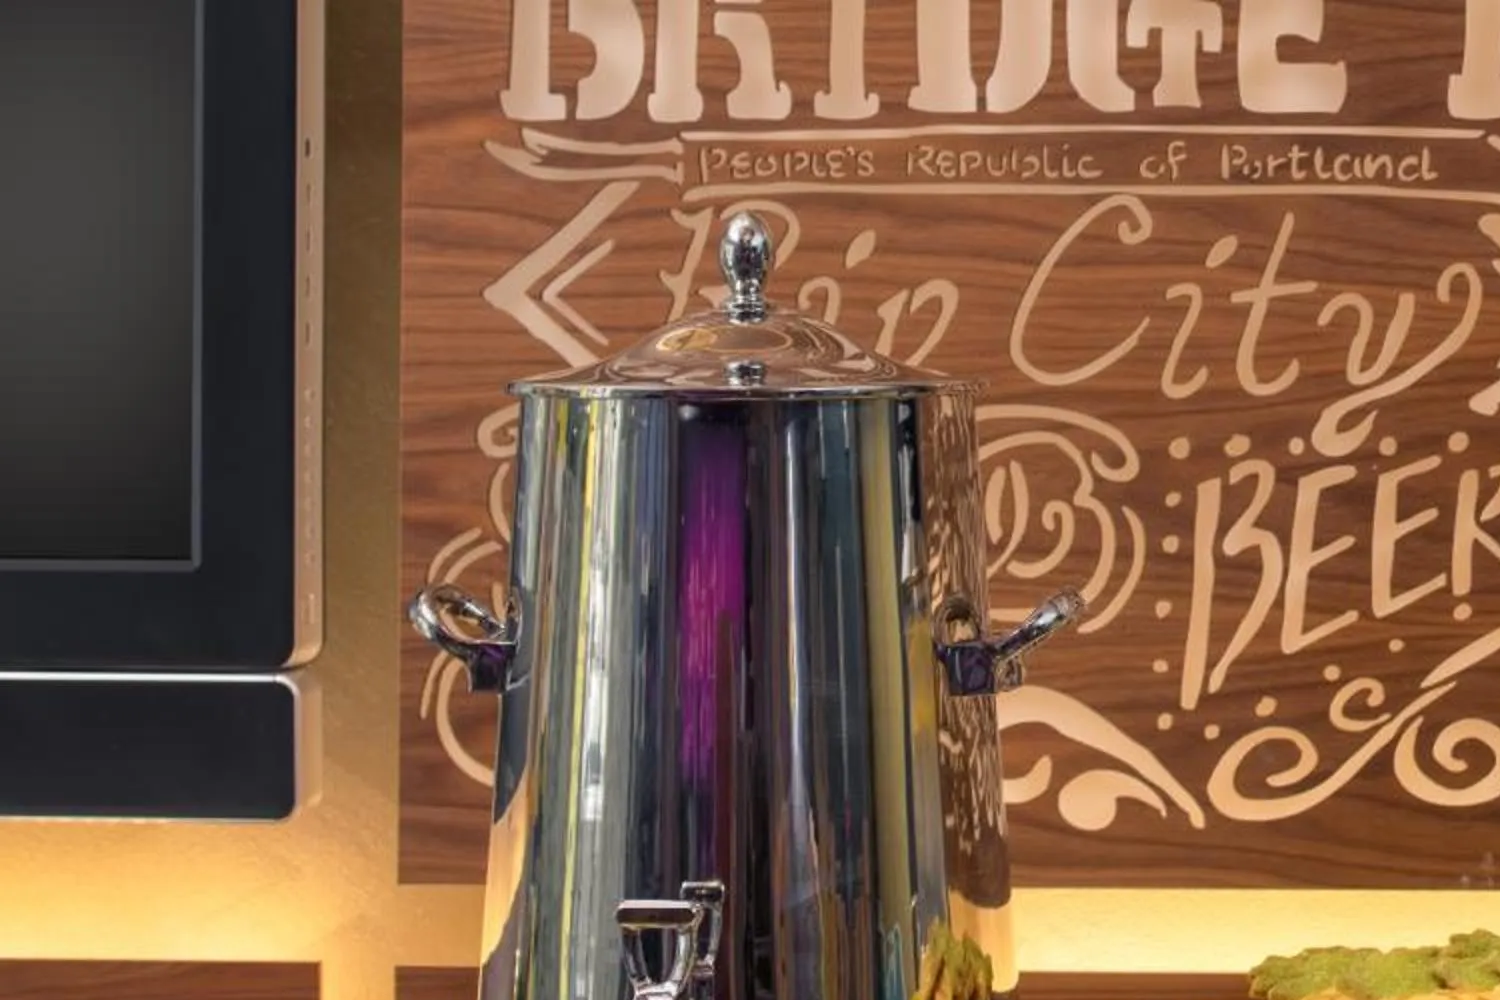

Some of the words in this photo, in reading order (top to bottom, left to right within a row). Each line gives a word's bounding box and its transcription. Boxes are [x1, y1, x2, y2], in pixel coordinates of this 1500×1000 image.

[1139, 140, 1189, 182] of
[1221, 144, 1438, 182] Portland
[1010, 194, 1484, 458] City
